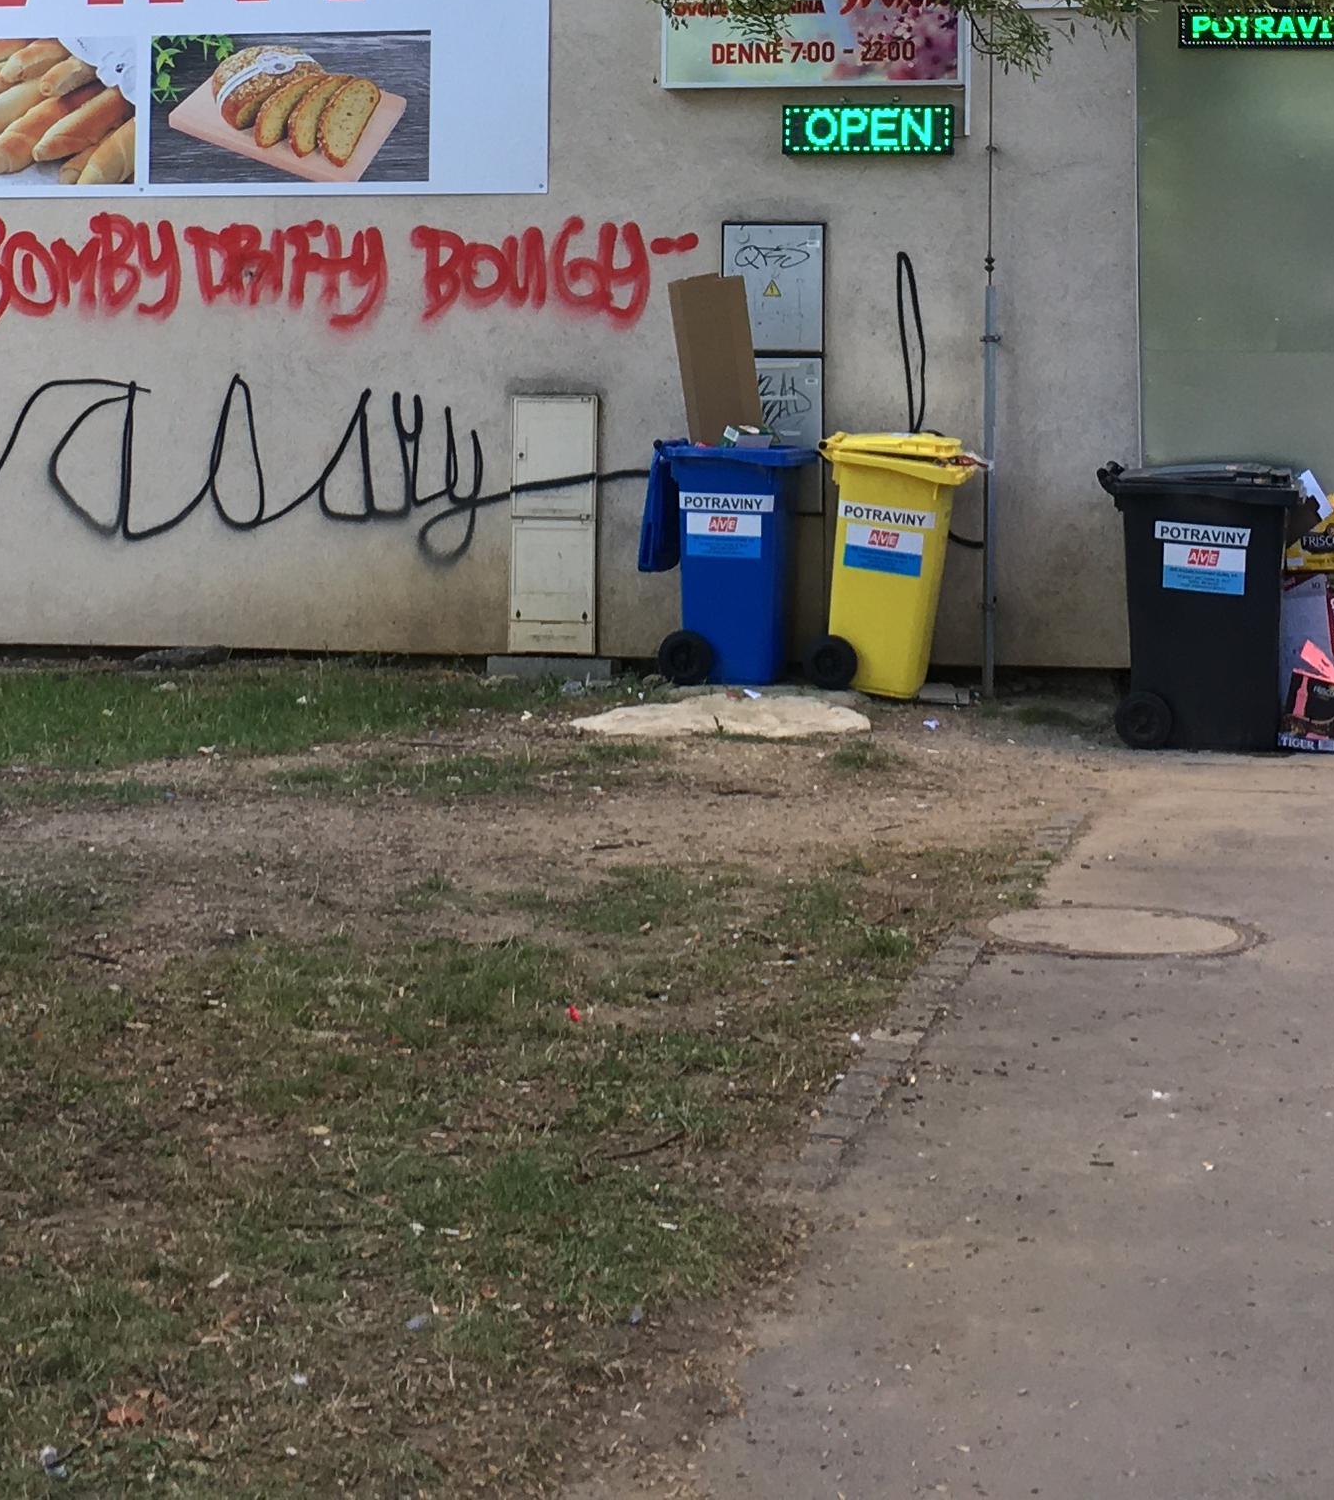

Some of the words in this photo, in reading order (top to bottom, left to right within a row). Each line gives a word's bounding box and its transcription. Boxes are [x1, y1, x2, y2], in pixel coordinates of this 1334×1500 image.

[790, 41, 835, 64] 7:00
[805, 109, 932, 146] OPEN
[684, 496, 763, 510] POTRAVINY
[708, 516, 738, 532] AVE
[844, 505, 926, 526] POTRAVINY
[868, 529, 900, 548] AVE
[1160, 525, 1246, 544] POTRAVINY
[1187, 548, 1220, 567] AVE
